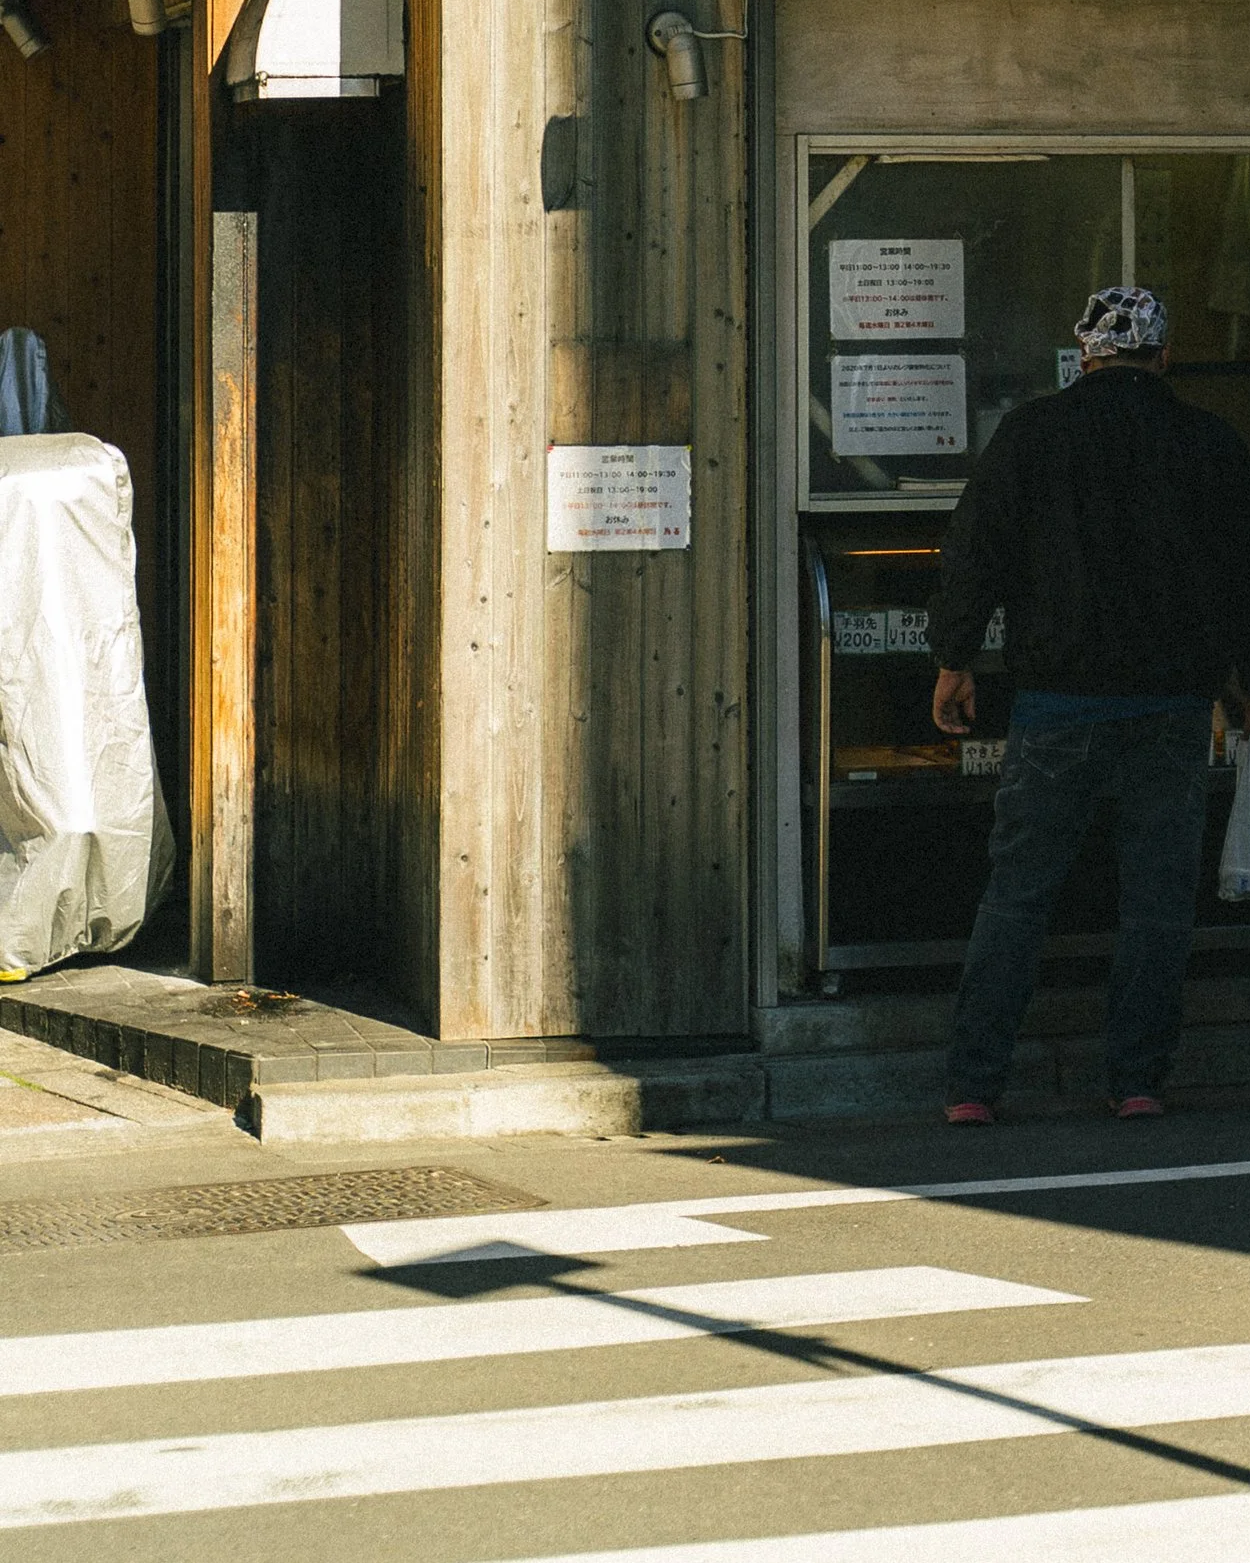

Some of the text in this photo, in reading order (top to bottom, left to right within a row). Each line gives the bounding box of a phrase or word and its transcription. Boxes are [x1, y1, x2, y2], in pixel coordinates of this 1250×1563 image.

[880, 247, 911, 256] 営業時間
[885, 308, 909, 317] お休み
[842, 617, 878, 630] 手羽先
[901, 614, 927, 628] 砂肝
[965, 745, 1001, 760] やきと
